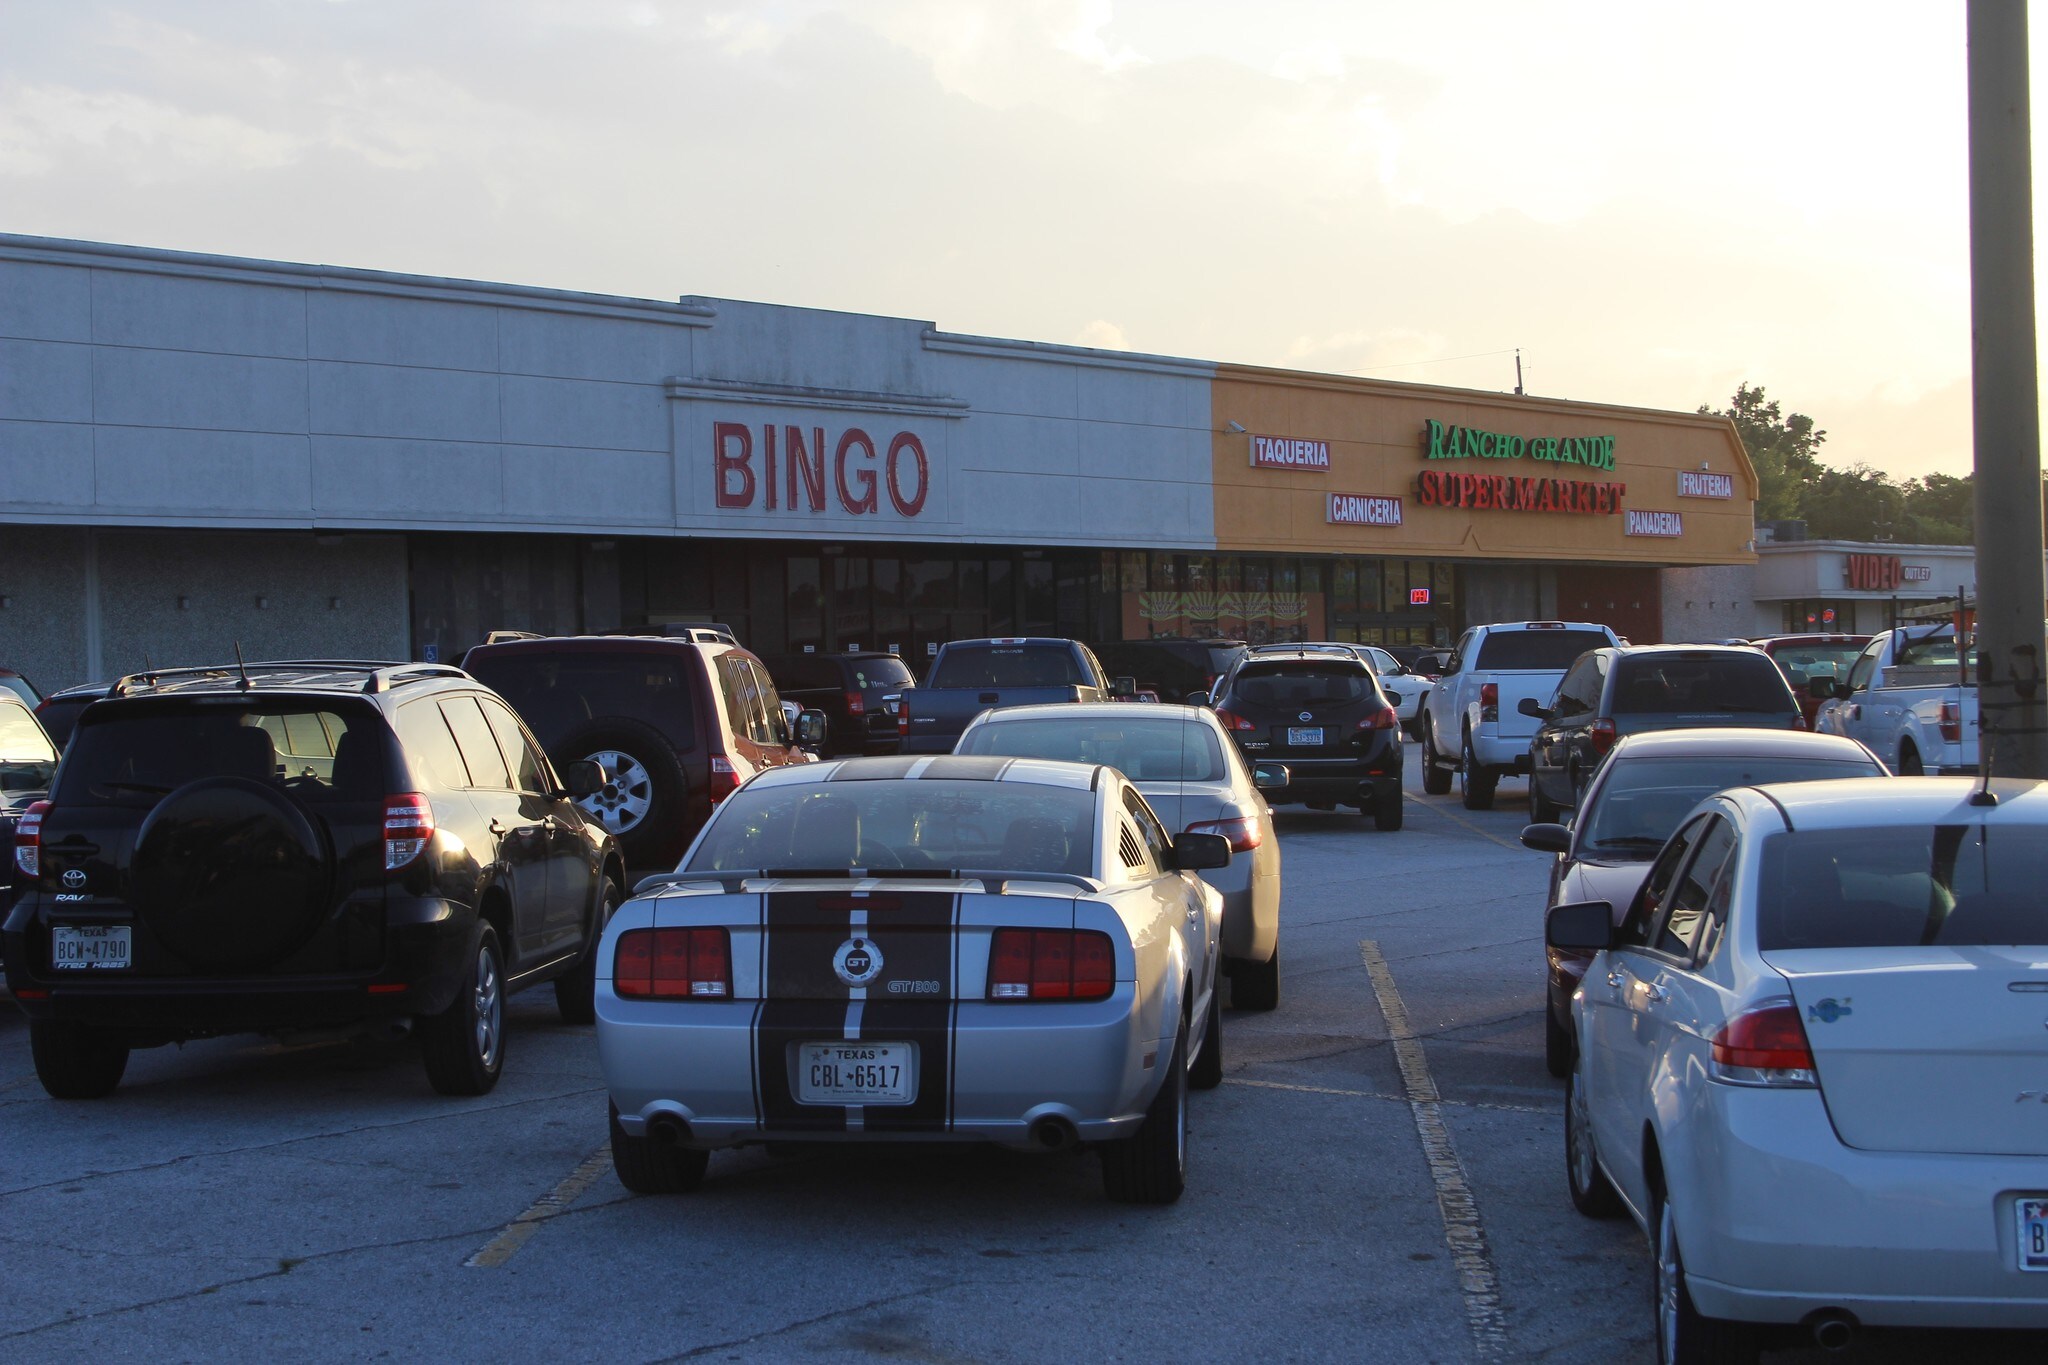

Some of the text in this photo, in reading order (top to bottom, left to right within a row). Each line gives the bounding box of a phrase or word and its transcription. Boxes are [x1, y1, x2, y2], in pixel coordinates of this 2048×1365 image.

[1256, 436, 1329, 467] TAQUERIA
[1427, 418, 1616, 472] RANCHO GRANDE
[713, 420, 930, 518] BINGO
[1420, 469, 1626, 515] SUPER MARKET
[1682, 472, 1732, 498] FRUTERIA
[1332, 495, 1402, 526] CARNICERIA
[1629, 511, 1683, 537] PANADERIA
[1849, 554, 1930, 590] VIDEO OUTLET
[55, 894, 93, 903] RAV4
[79, 929, 107, 937] TEXAS
[91, 940, 126, 959] 4790
[847, 957, 869, 967] GT
[886, 979, 941, 993] GT/300
[836, 1049, 876, 1061] TEXAS
[810, 1065, 901, 1088] CBL 6517
